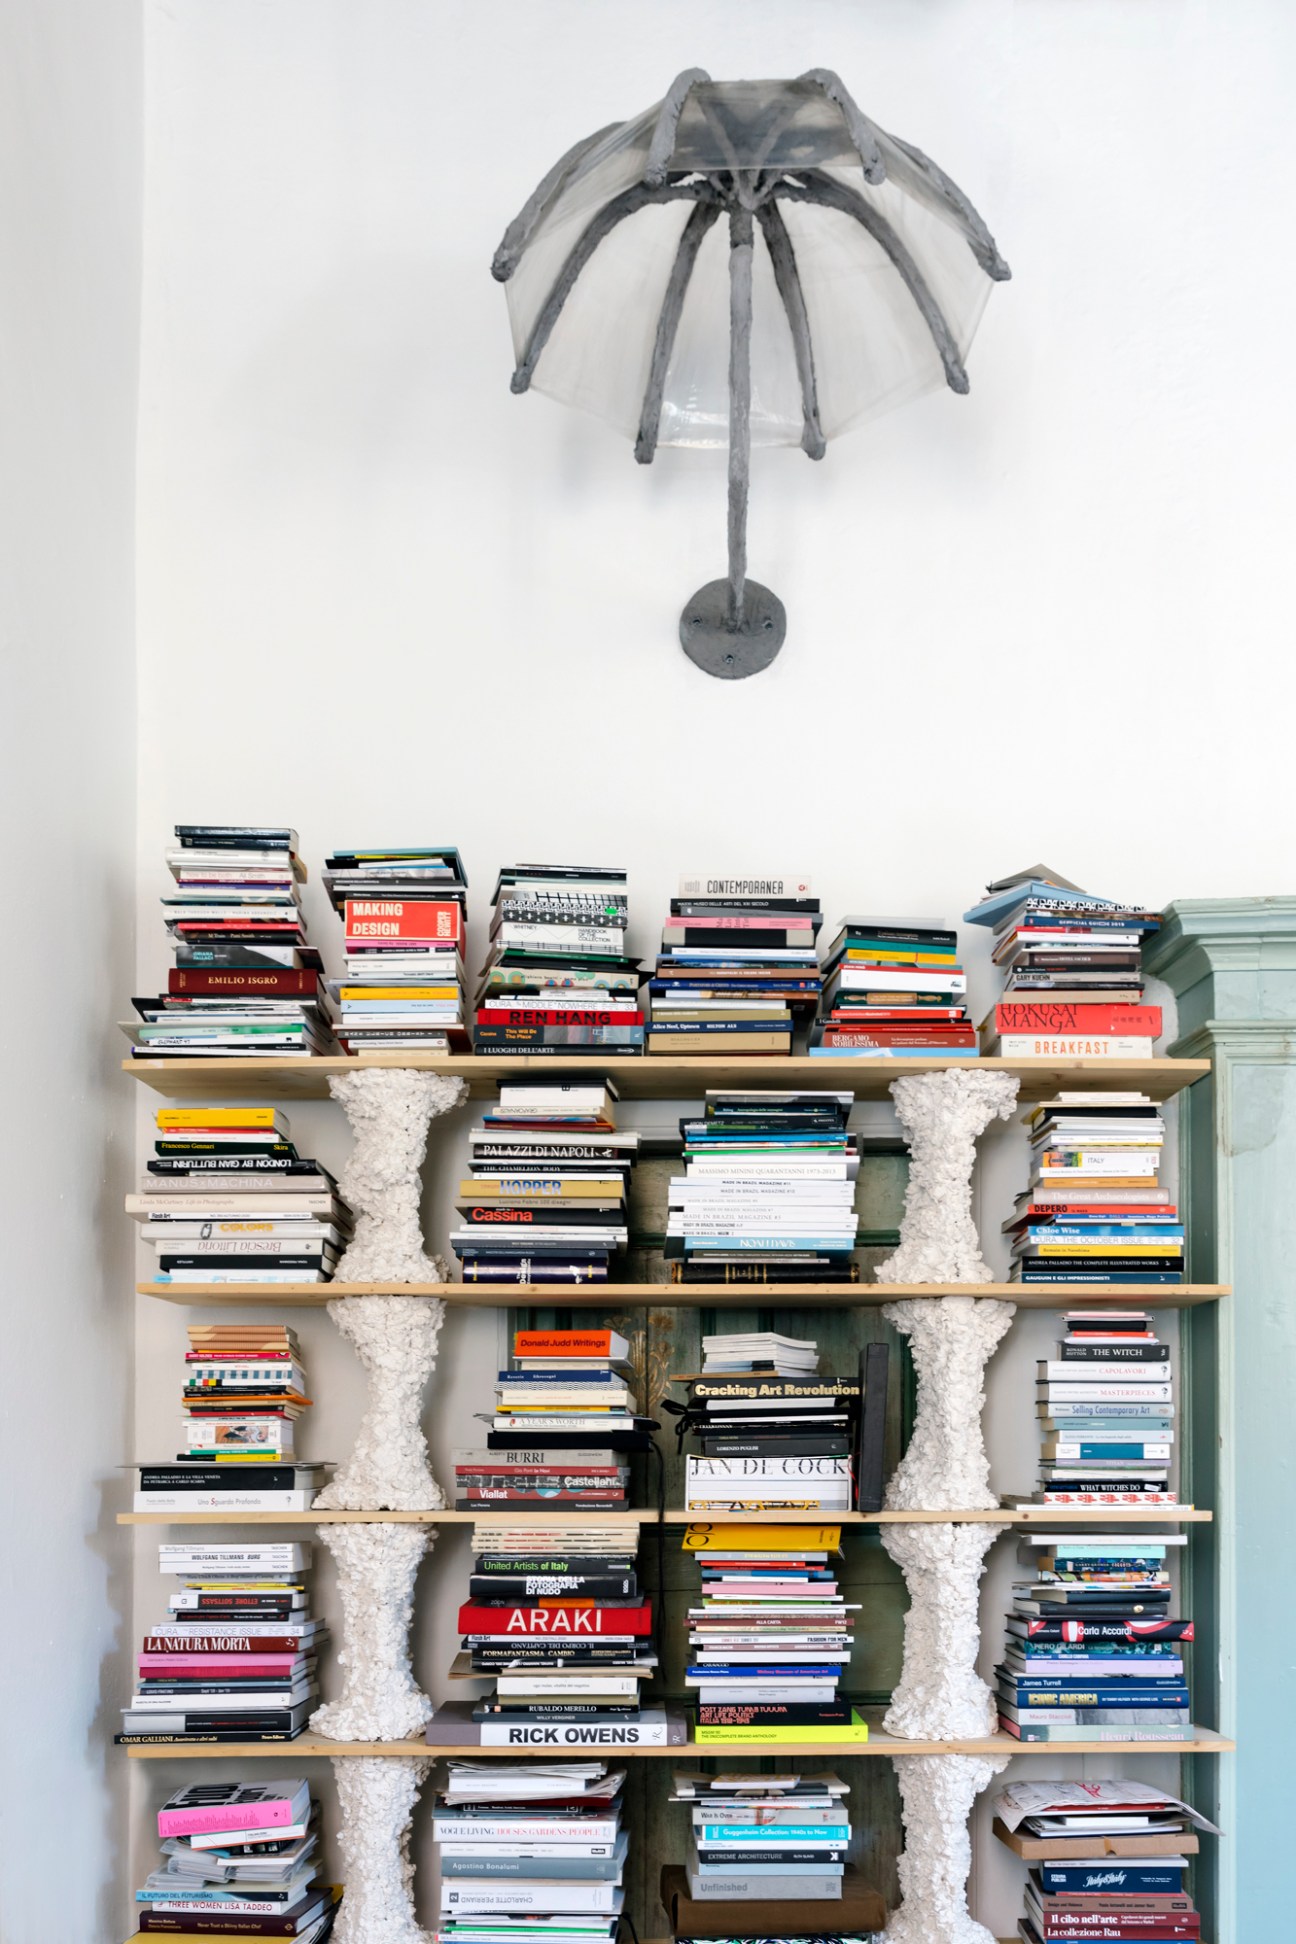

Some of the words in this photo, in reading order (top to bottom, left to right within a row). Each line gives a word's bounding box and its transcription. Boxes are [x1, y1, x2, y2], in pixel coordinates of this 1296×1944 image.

[707, 880, 783, 895] CONTEMPORANEA
[353, 903, 403, 916] MAKING
[353, 923, 400, 936] DESIGN
[248, 976, 278, 984] ISGRÒ
[1000, 1004, 1077, 1015] HOKUSAI
[510, 1012, 547, 1024] REN
[556, 1012, 611, 1025] HANG
[1000, 1013, 1077, 1033] MANGA
[1035, 1042, 1109, 1054] BREAKFAST
[484, 1145, 532, 1157] PALAZZI
[535, 1147, 549, 1157] DI
[551, 1147, 595, 1158] NAPOLI
[500, 1180, 561, 1195] HOPPER
[1070, 1192, 1091, 1200] Great
[472, 1208, 532, 1222] Cassina
[220, 1223, 274, 1232] COLORS
[573, 1340, 606, 1348] Writings
[695, 1384, 757, 1398] Cracking
[759, 1384, 781, 1395] Art
[785, 1384, 860, 1396] Revolution
[1072, 1406, 1093, 1415] Selling
[1095, 1406, 1138, 1415] Contemporary
[506, 1453, 544, 1463] BURRI
[691, 1460, 732, 1475] JAN
[743, 1460, 772, 1475] DE
[782, 1460, 846, 1475] COCK
[480, 1490, 507, 1498] Viallat
[484, 1562, 511, 1570] United
[513, 1562, 538, 1570] Artists
[541, 1562, 549, 1570] of
[551, 1562, 568, 1572] Italy
[506, 1609, 602, 1632] ARAKI
[1078, 1626, 1100, 1635] Carla
[1102, 1626, 1132, 1635] Accardi
[147, 1638, 162, 1650] LA
[164, 1638, 208, 1651] NATURA
[211, 1638, 250, 1650] MORTA
[1028, 1694, 1057, 1705] ICONIC
[1060, 1694, 1098, 1705] AMERICA
[509, 1728, 559, 1743] RICK
[565, 1728, 639, 1743] OWENS
[1101, 1732, 1130, 1740] Henri
[1133, 1732, 1184, 1741] Rousseau
[701, 1883, 747, 1892] Unfinished
[1052, 1914, 1058, 1923] Il
[1060, 1914, 1079, 1924] cibo
[1082, 1914, 1118, 1924] nell'arte
[1047, 1928, 1058, 1936] La
[1060, 1928, 1102, 1936] collezione
[1104, 1928, 1121, 1937] Rau
